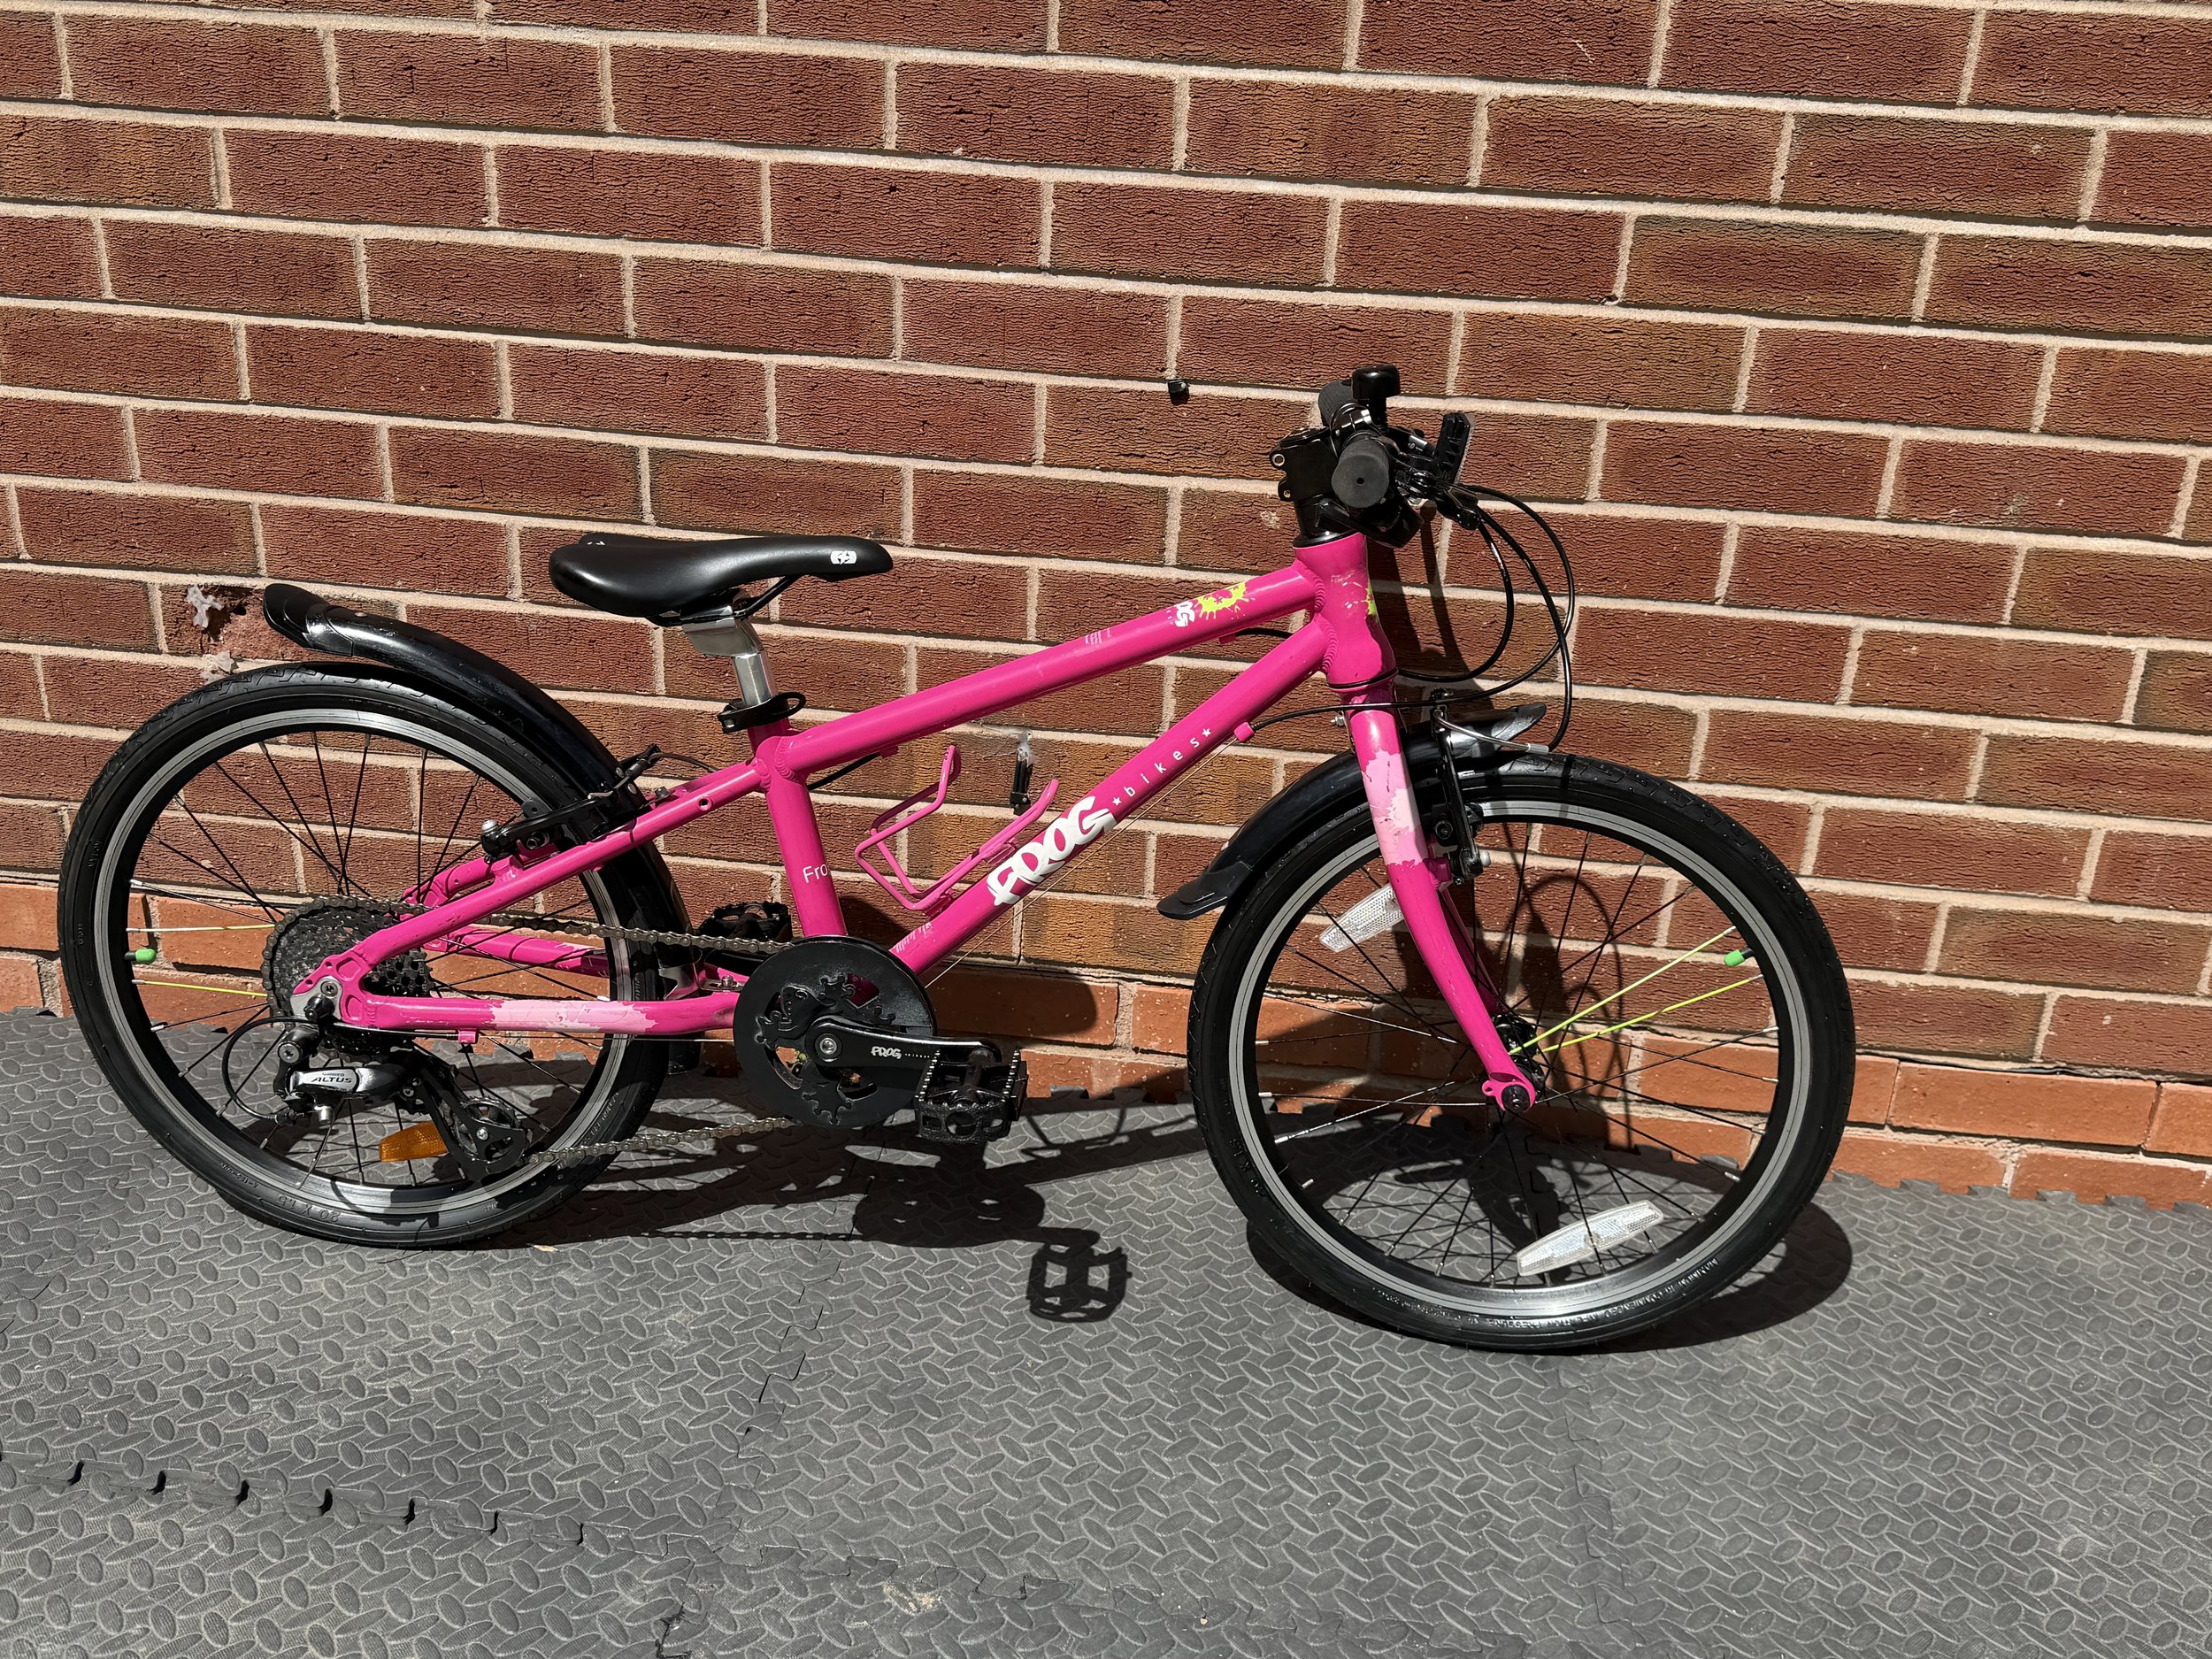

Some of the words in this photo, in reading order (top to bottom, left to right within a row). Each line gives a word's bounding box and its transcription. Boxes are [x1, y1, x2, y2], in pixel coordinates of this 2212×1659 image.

[1125, 738, 1200, 796] bikes
[987, 795, 1118, 906] FROG
[803, 864, 828, 883] Fro
[871, 1046, 902, 1059] FROG
